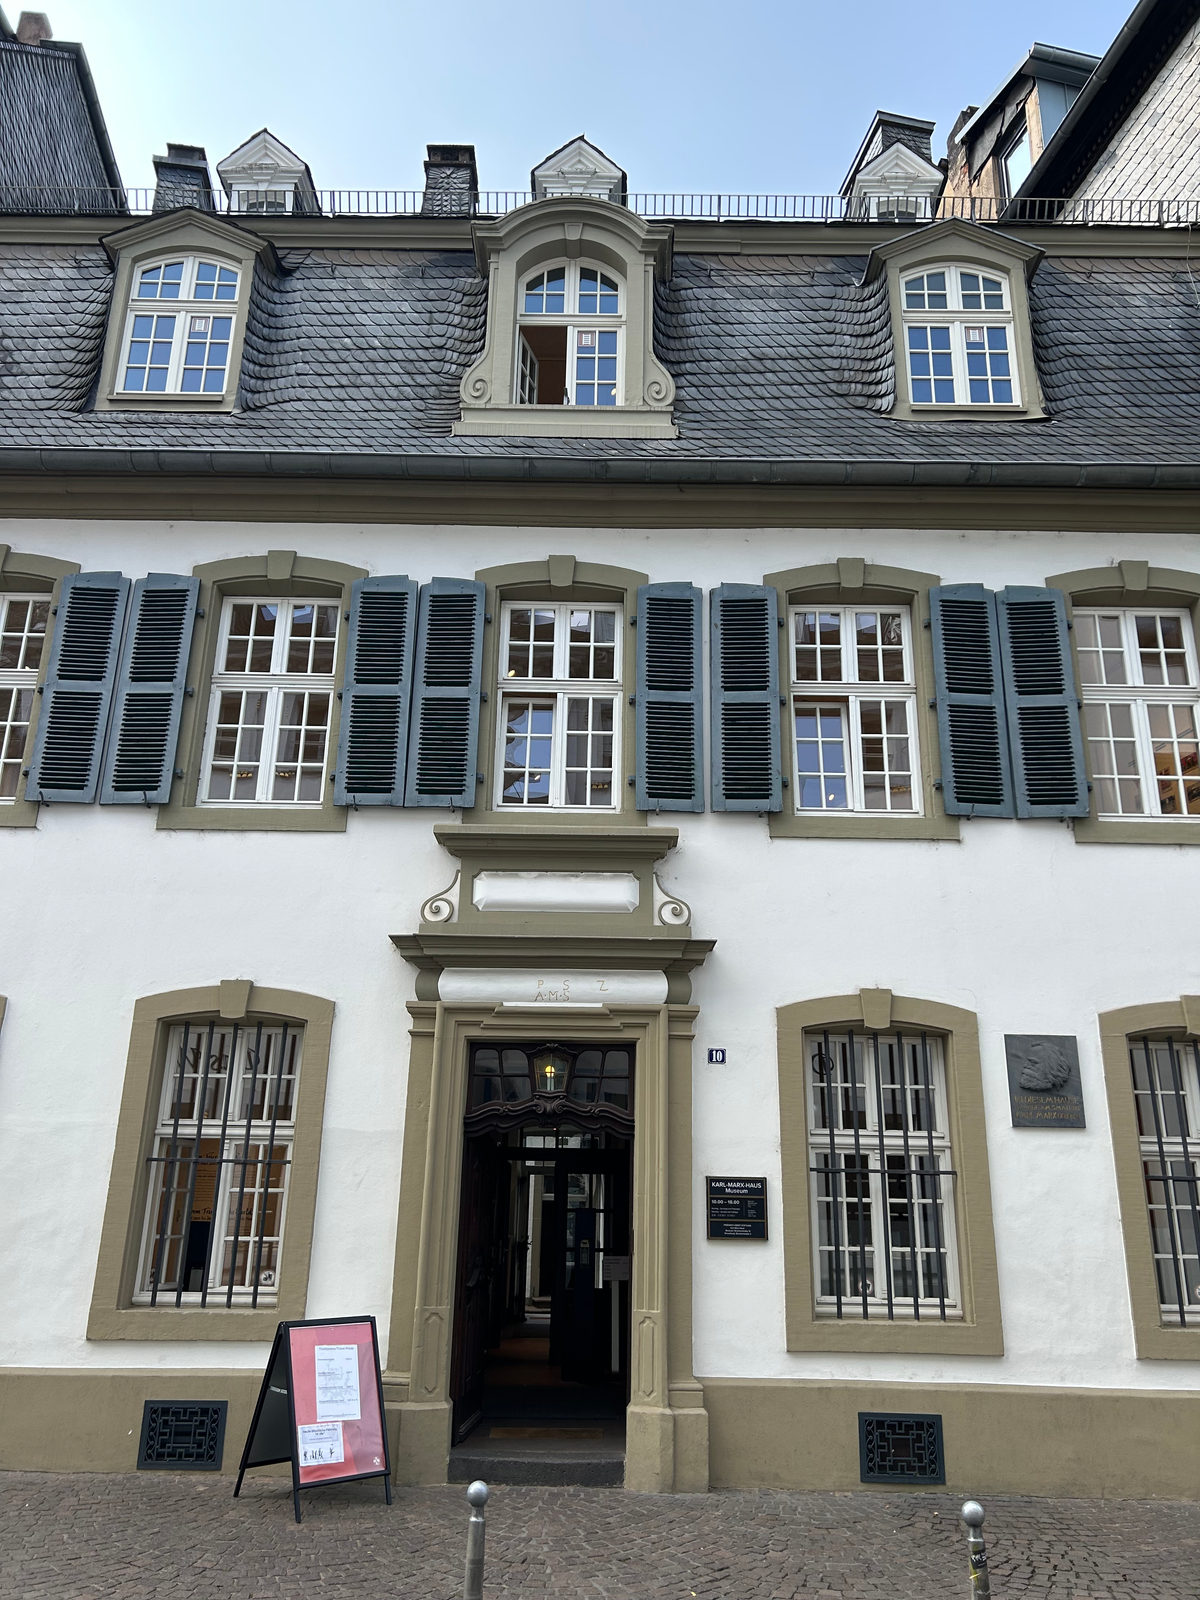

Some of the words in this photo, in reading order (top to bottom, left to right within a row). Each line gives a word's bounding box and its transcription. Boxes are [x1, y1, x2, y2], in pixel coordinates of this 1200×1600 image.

[563, 979, 570, 991] S
[596, 980, 609, 992] Z
[712, 1050, 723, 1062] 10
